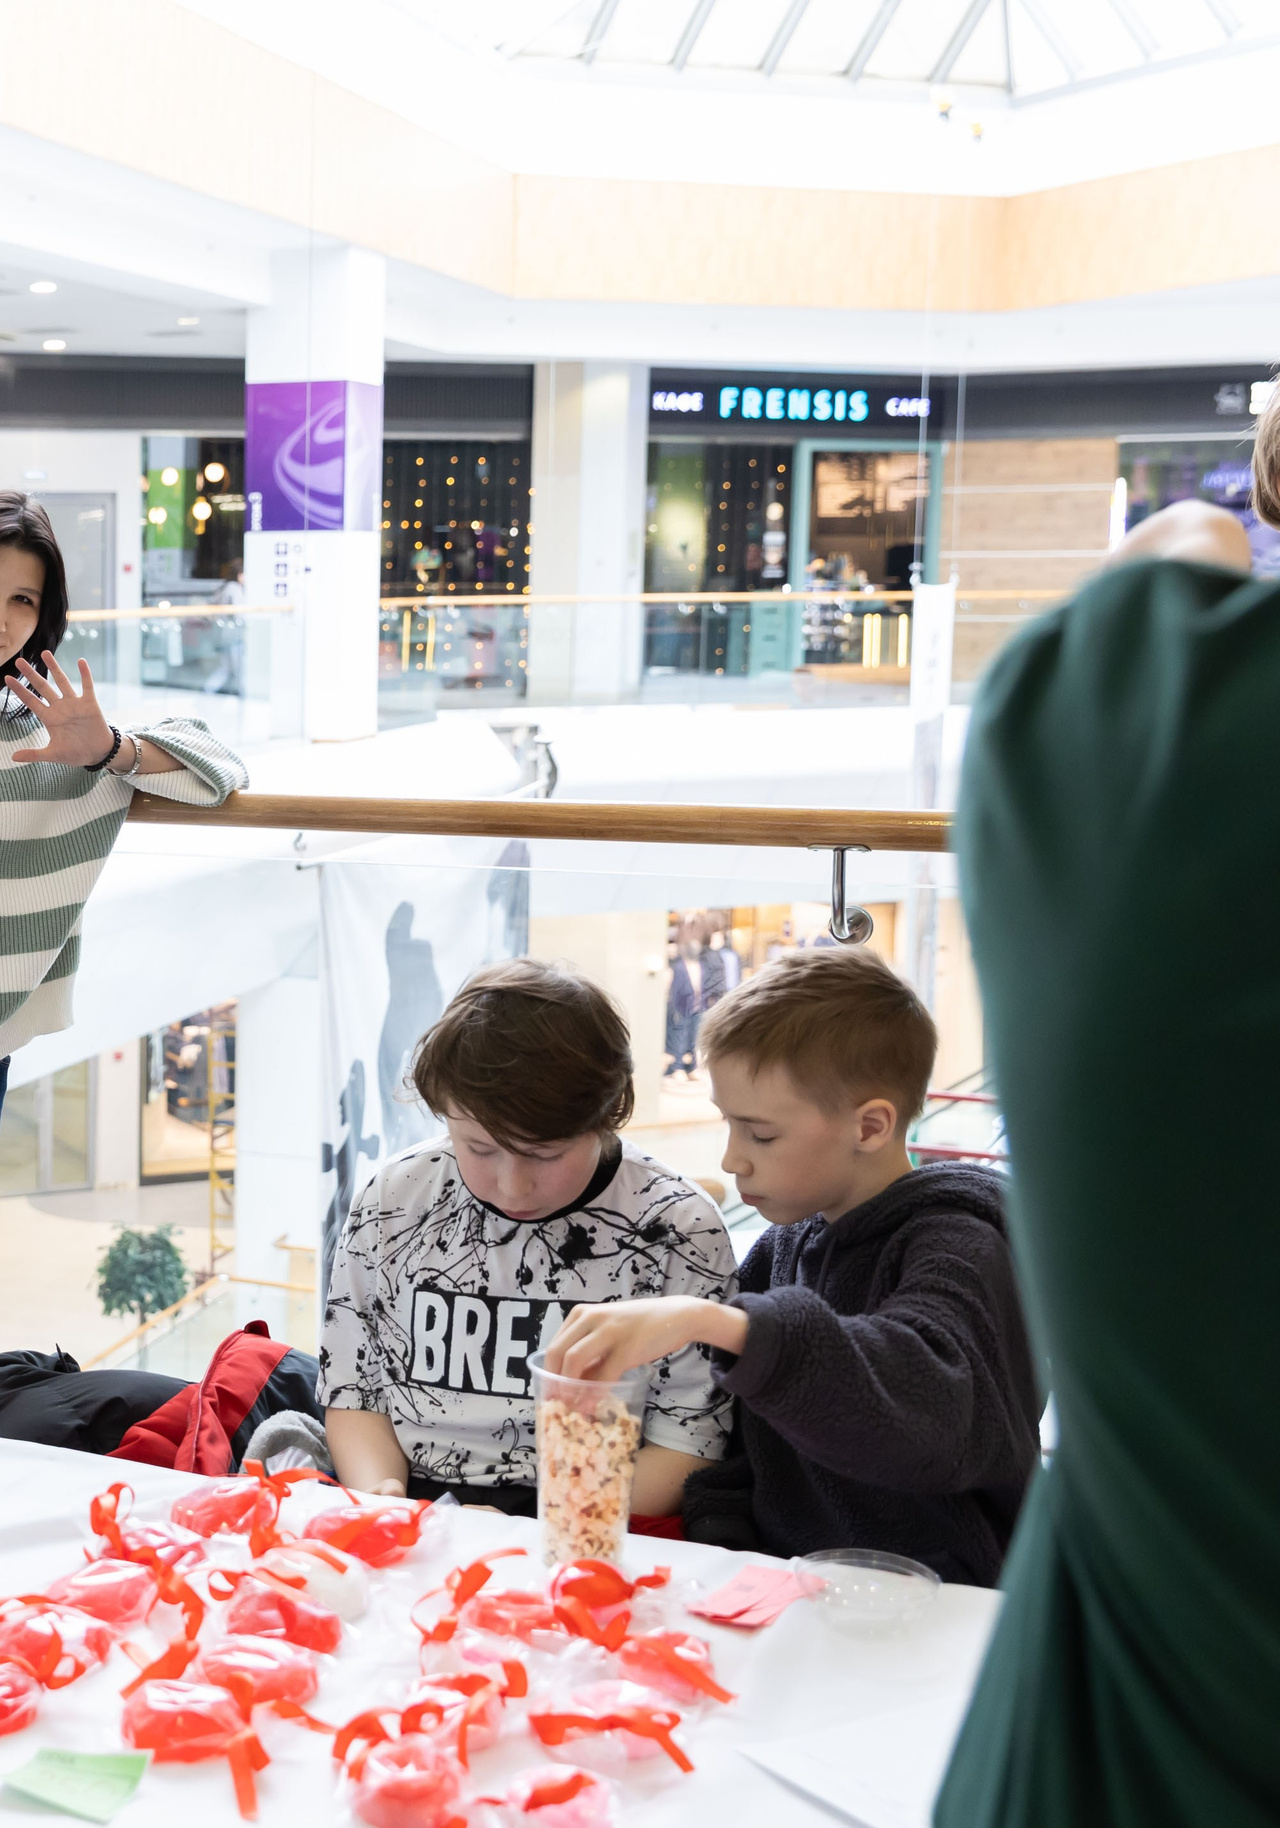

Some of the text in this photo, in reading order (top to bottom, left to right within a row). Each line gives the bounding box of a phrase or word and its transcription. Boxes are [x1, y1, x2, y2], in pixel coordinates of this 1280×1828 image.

[652, 391, 704, 412] КАФЕ
[719, 386, 869, 422] FRENSIS
[410, 1291, 566, 1397] BREA
